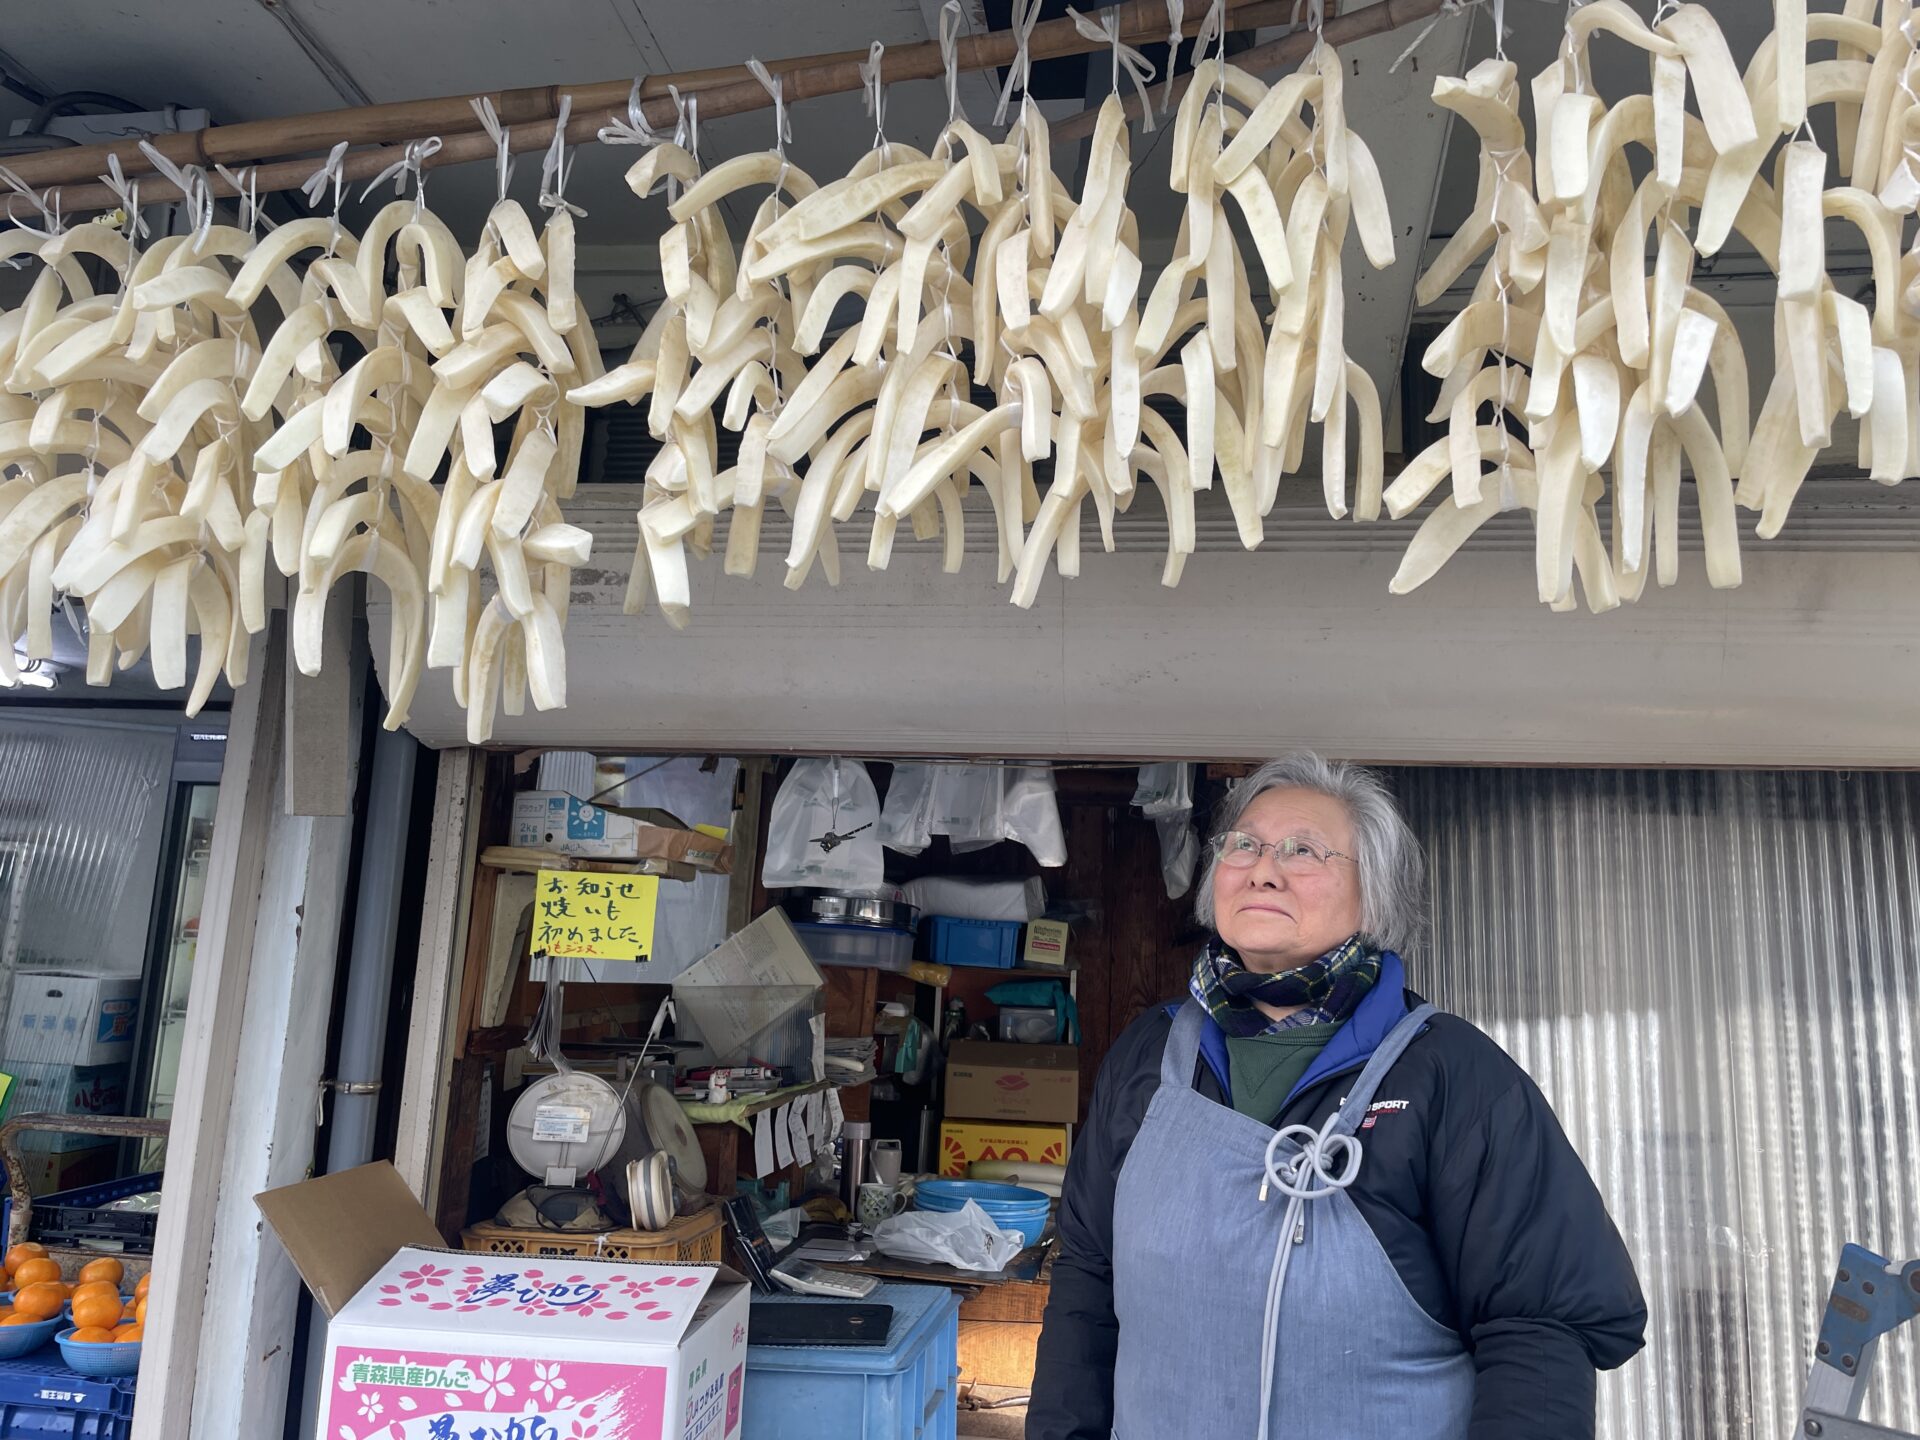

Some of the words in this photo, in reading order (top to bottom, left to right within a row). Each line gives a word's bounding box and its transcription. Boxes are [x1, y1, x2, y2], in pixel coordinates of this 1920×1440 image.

[520, 823, 538, 833] 2kg
[543, 877, 641, 899] お知らせ
[540, 896, 622, 920] 焼いも
[1371, 1099, 1410, 1111] SPORT
[351, 1363, 471, 1390] 青森県産りんご
